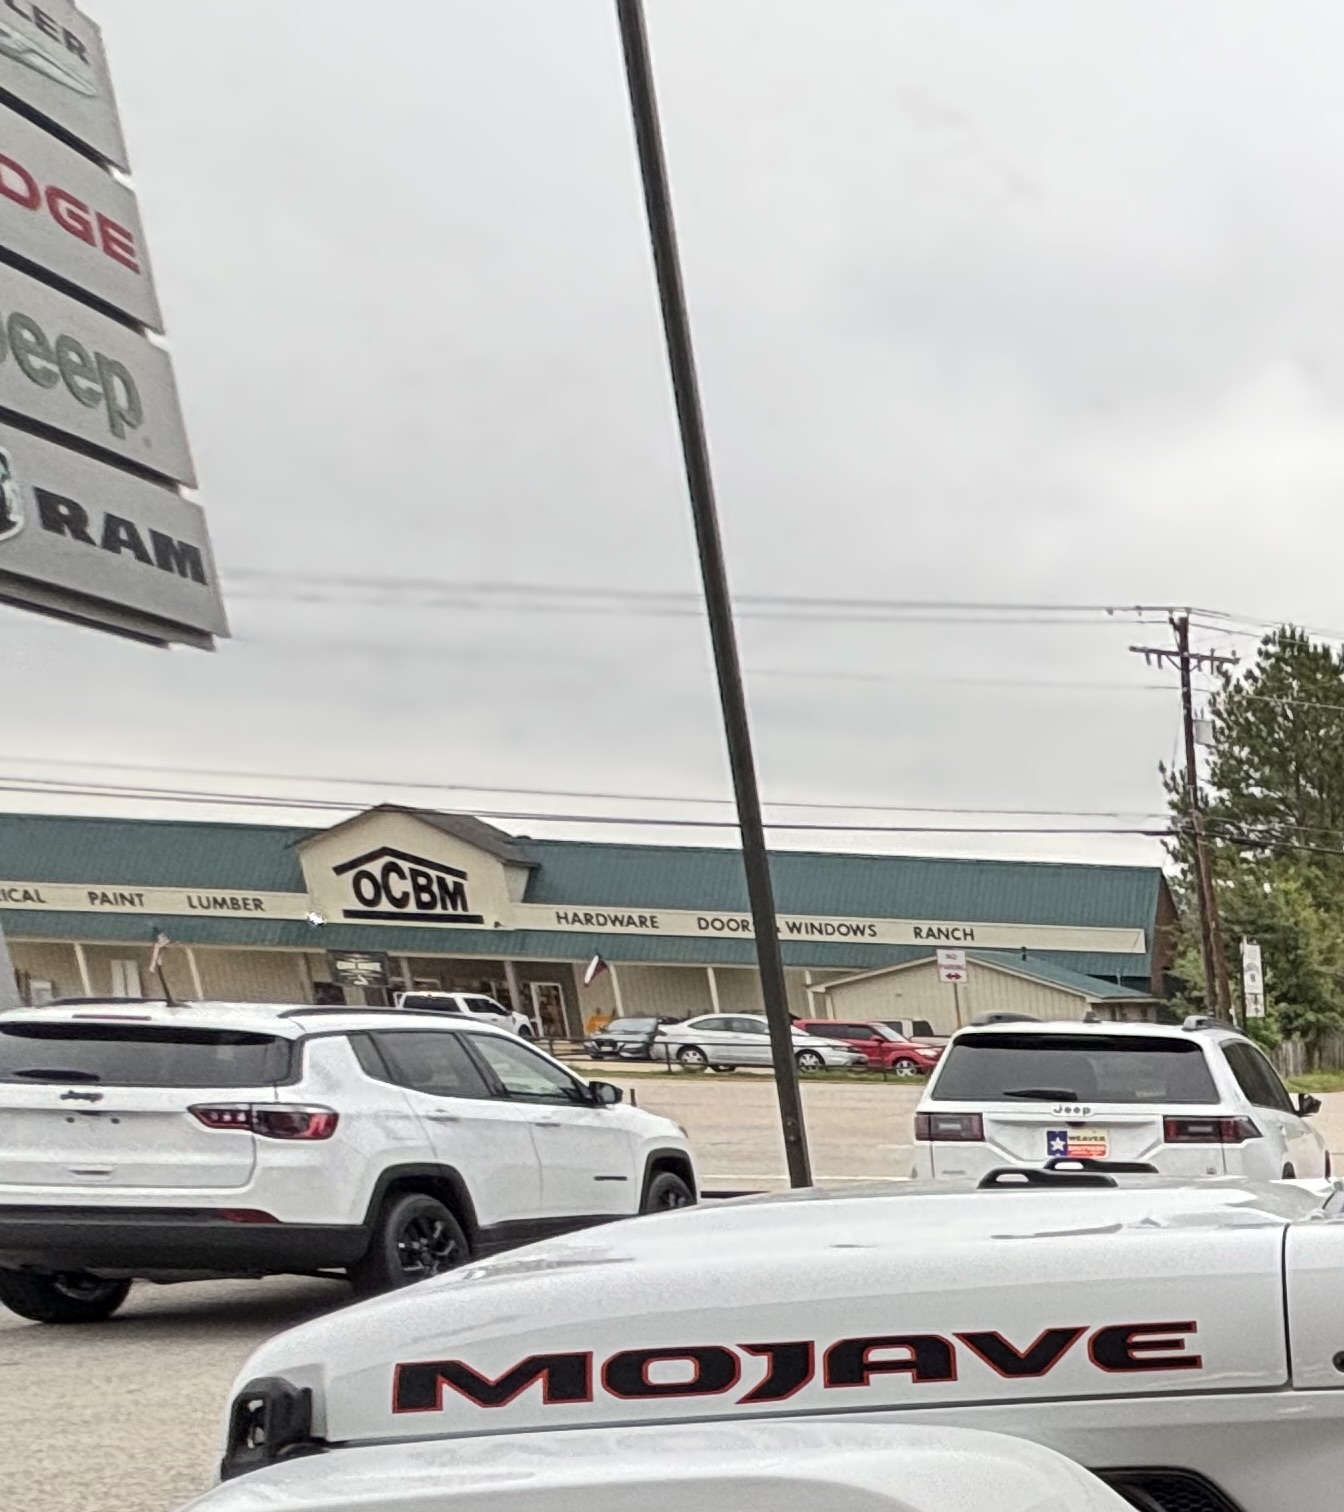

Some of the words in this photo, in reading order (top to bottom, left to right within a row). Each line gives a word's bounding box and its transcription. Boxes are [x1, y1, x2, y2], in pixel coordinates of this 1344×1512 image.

[0, 302, 144, 441] eep
[32, 485, 208, 586] RAM
[0, 888, 48, 903] ICAL
[87, 891, 144, 907] PAINT
[186, 895, 265, 912] LUMBER
[353, 861, 468, 912] OCBM
[555, 911, 660, 929] HARDWARE
[697, 917, 753, 932] DOOR
[785, 920, 877, 937] WINDOWS
[913, 926, 975, 941] RANCH
[1053, 1104, 1091, 1117] Jeep
[391, 1320, 1203, 1414] MOJAVE
